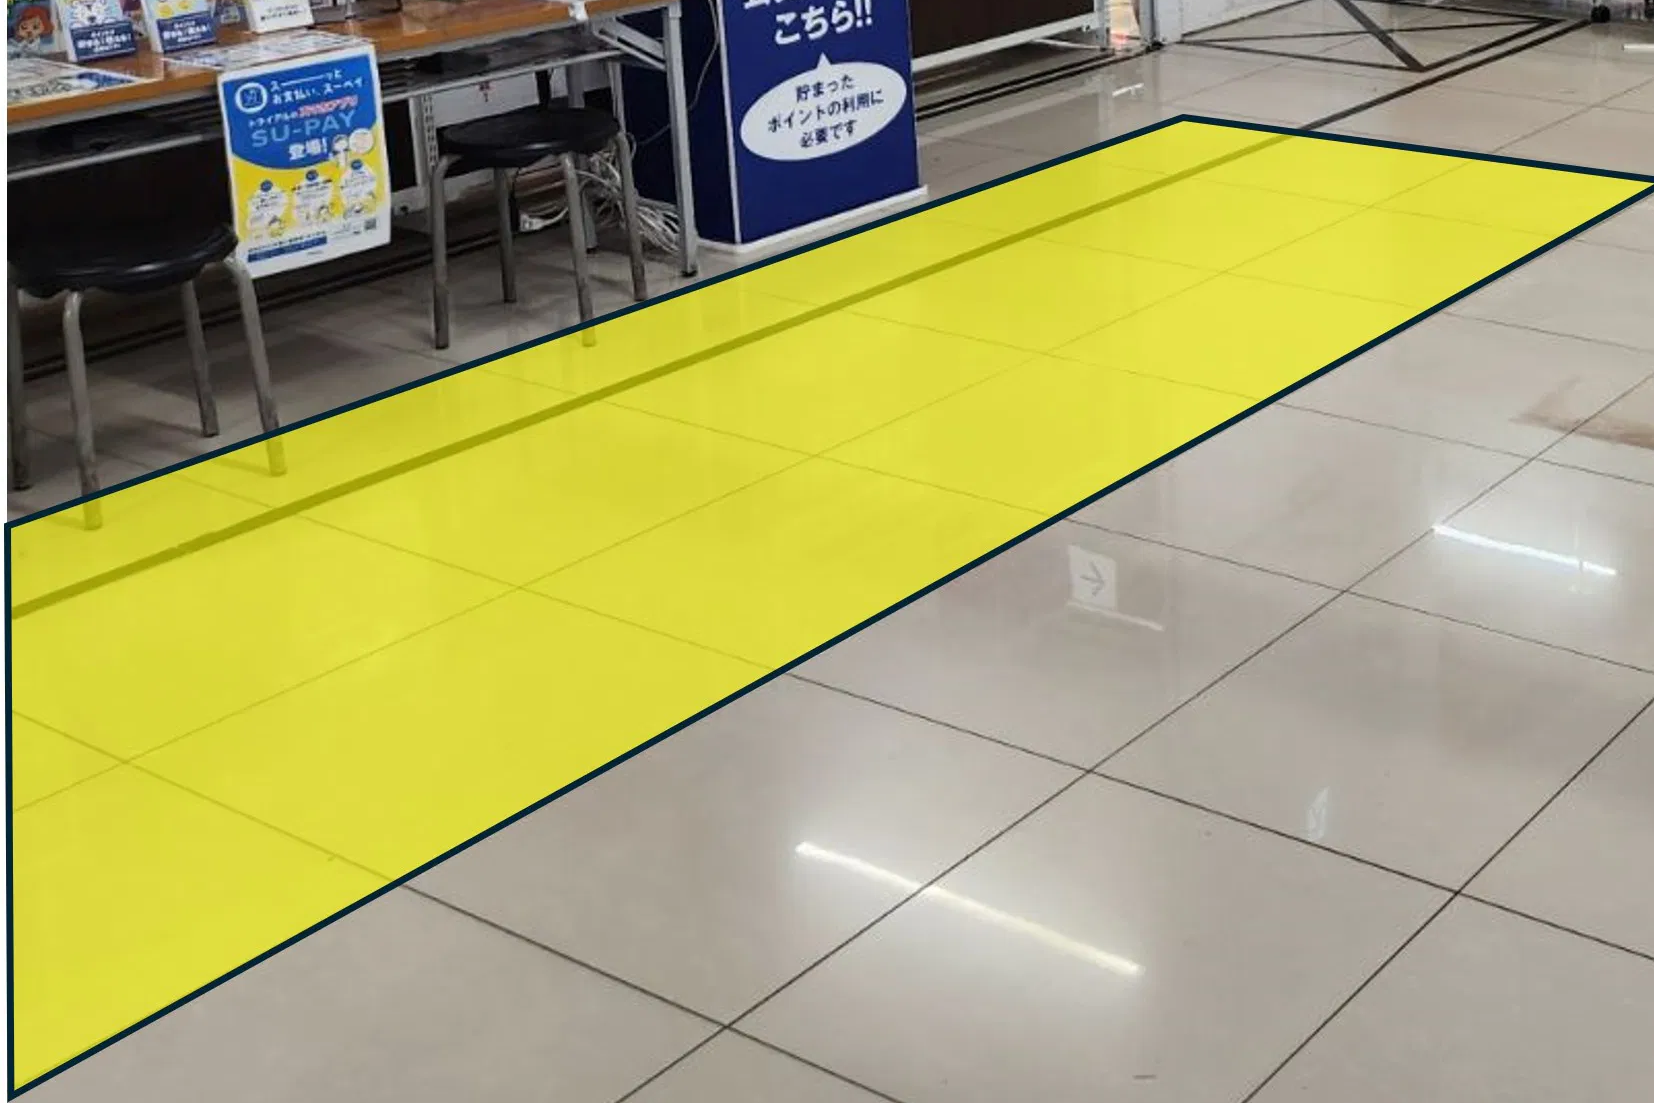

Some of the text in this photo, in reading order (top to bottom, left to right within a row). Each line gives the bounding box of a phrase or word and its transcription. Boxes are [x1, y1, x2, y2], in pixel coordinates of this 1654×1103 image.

[795, 73, 855, 102] 貯まった
[251, 109, 356, 148] SU-PAY
[767, 90, 885, 134] ポイントの利用に
[799, 119, 858, 148] 必要です
